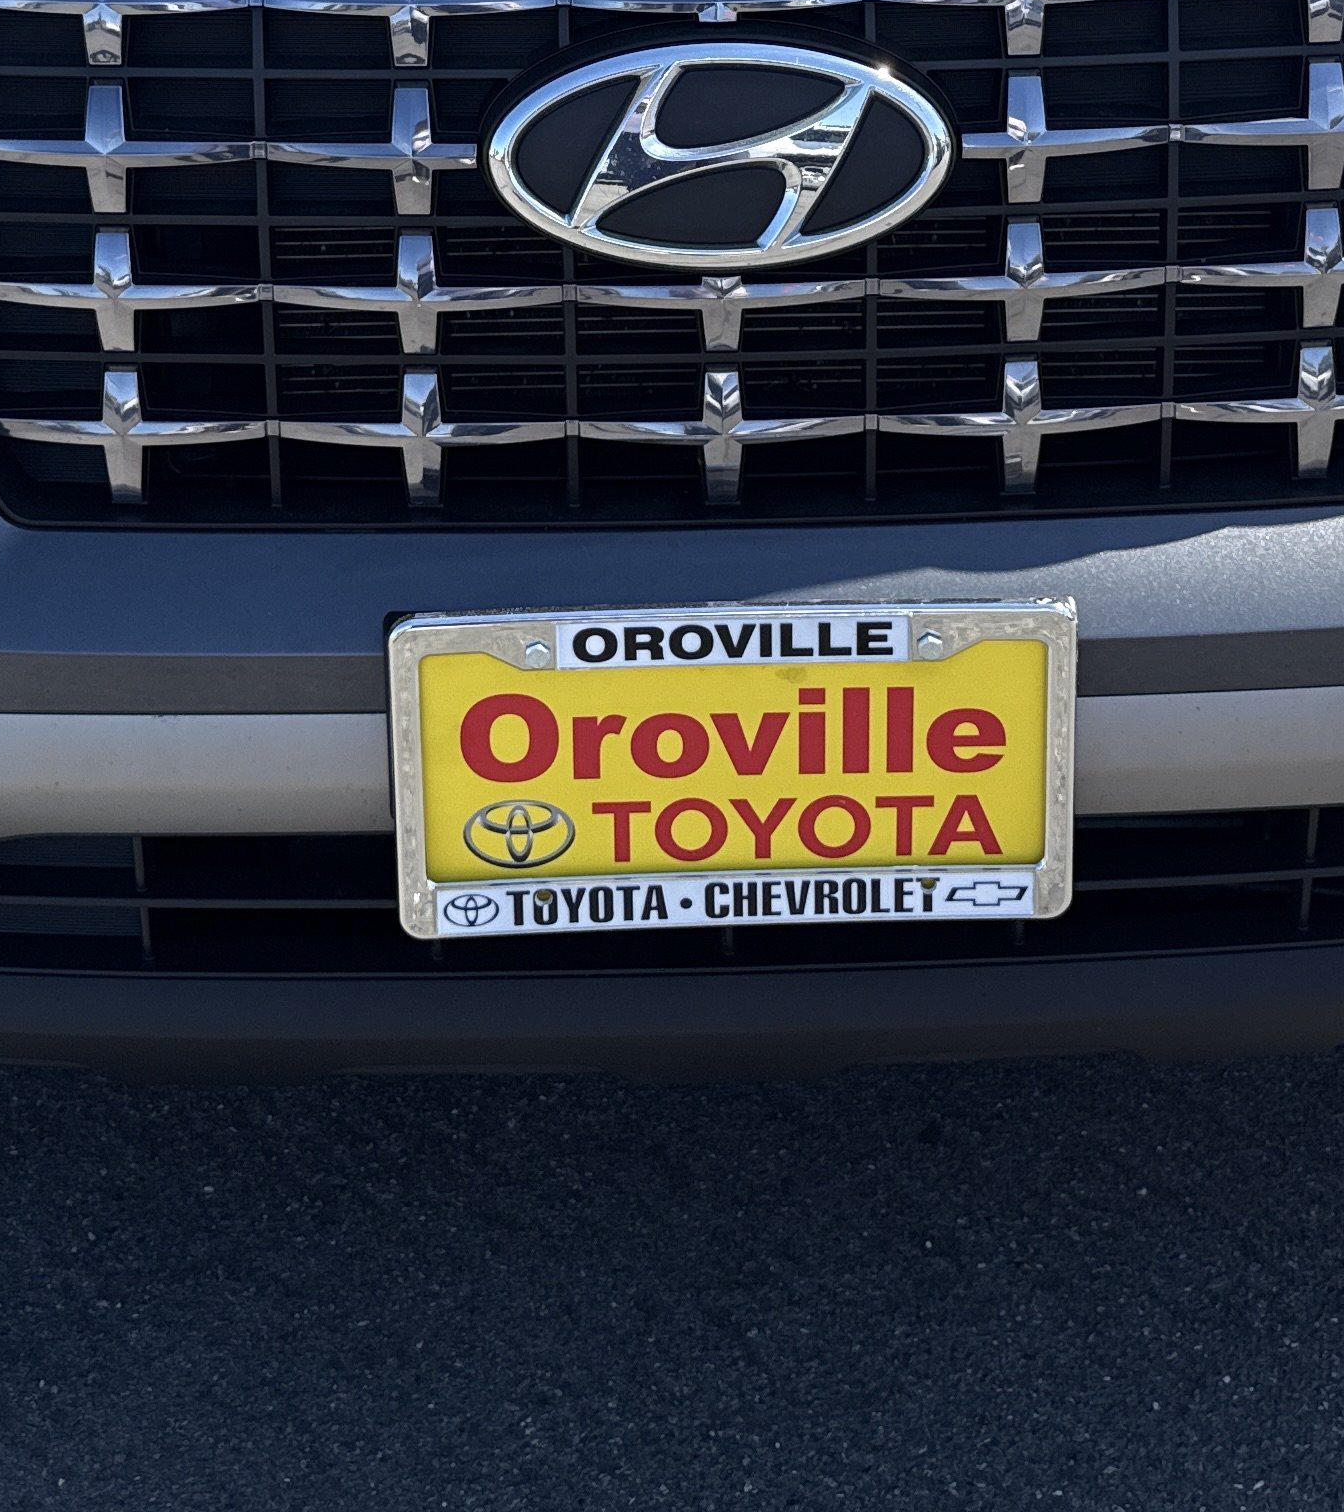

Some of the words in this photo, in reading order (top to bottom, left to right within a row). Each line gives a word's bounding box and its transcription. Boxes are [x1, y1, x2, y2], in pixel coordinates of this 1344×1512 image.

[572, 622, 895, 663] OROVILLE
[459, 686, 1007, 783] Oroville
[591, 794, 1004, 863] TOYOTA
[506, 884, 669, 926] TOYOTA
[703, 877, 941, 919] CHEVROLET
